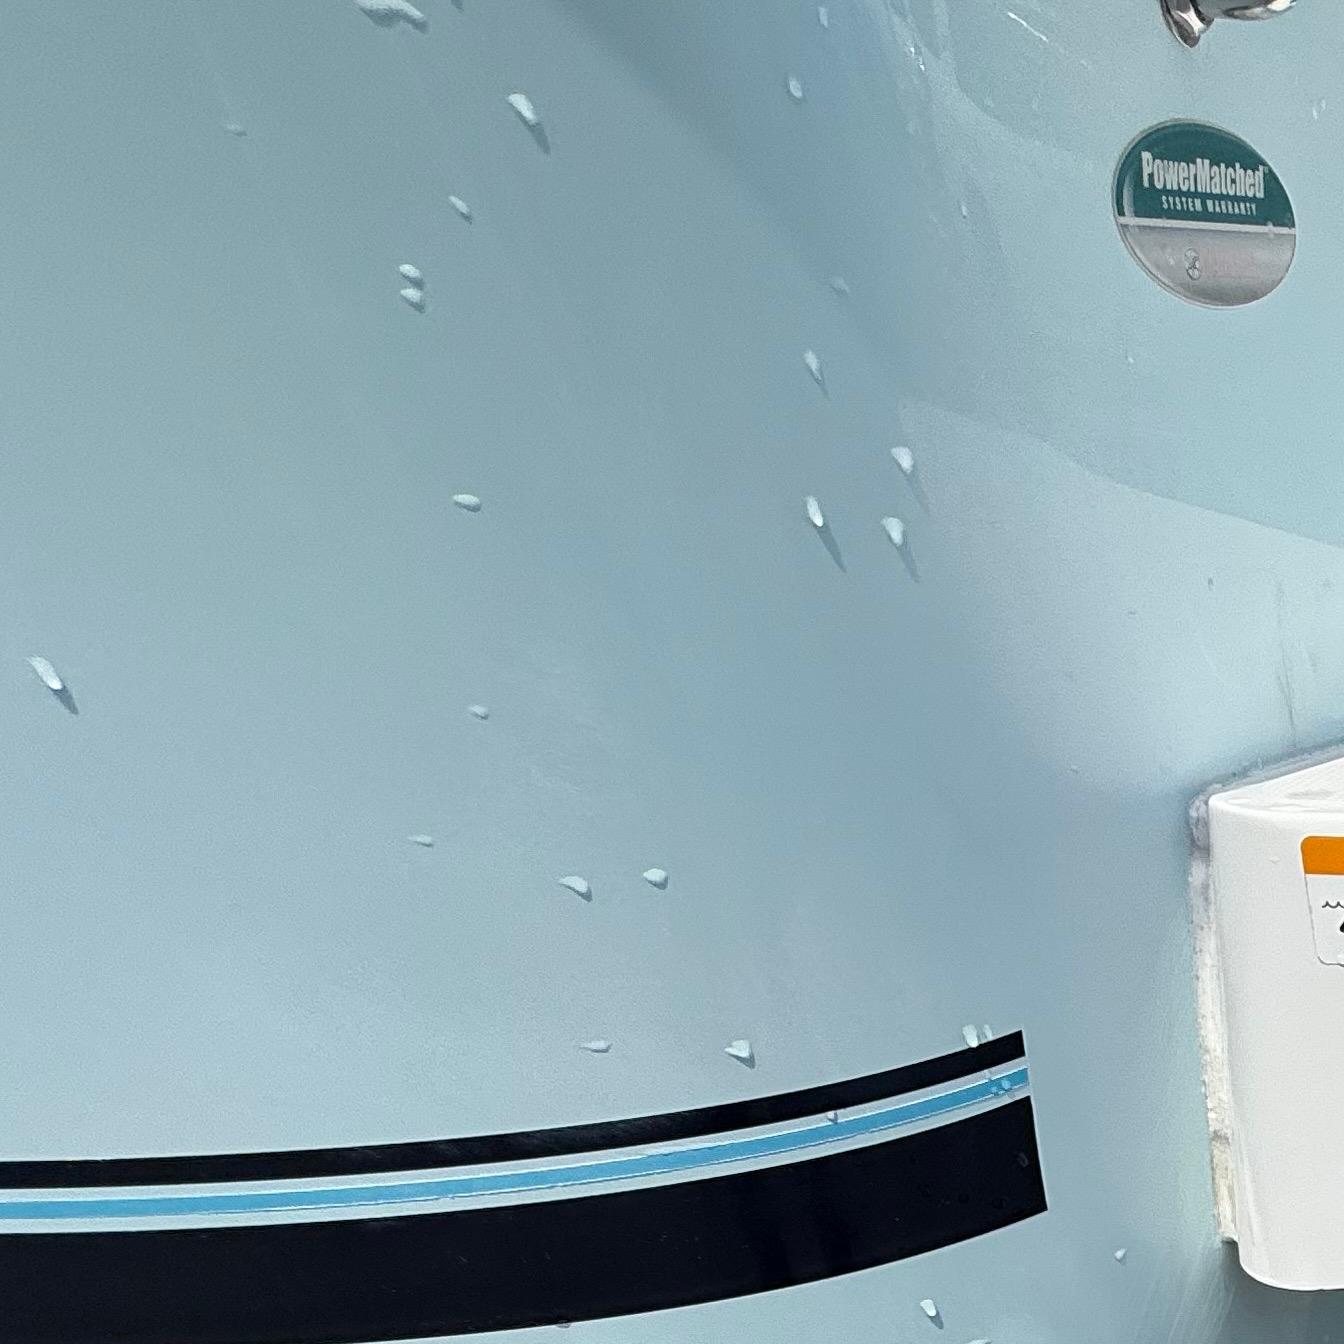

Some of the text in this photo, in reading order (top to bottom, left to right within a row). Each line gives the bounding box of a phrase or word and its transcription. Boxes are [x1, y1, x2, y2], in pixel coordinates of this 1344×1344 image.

[1141, 150, 1265, 199] PowerMatched
[1161, 195, 1257, 216] SYSTEM WARRANTY
